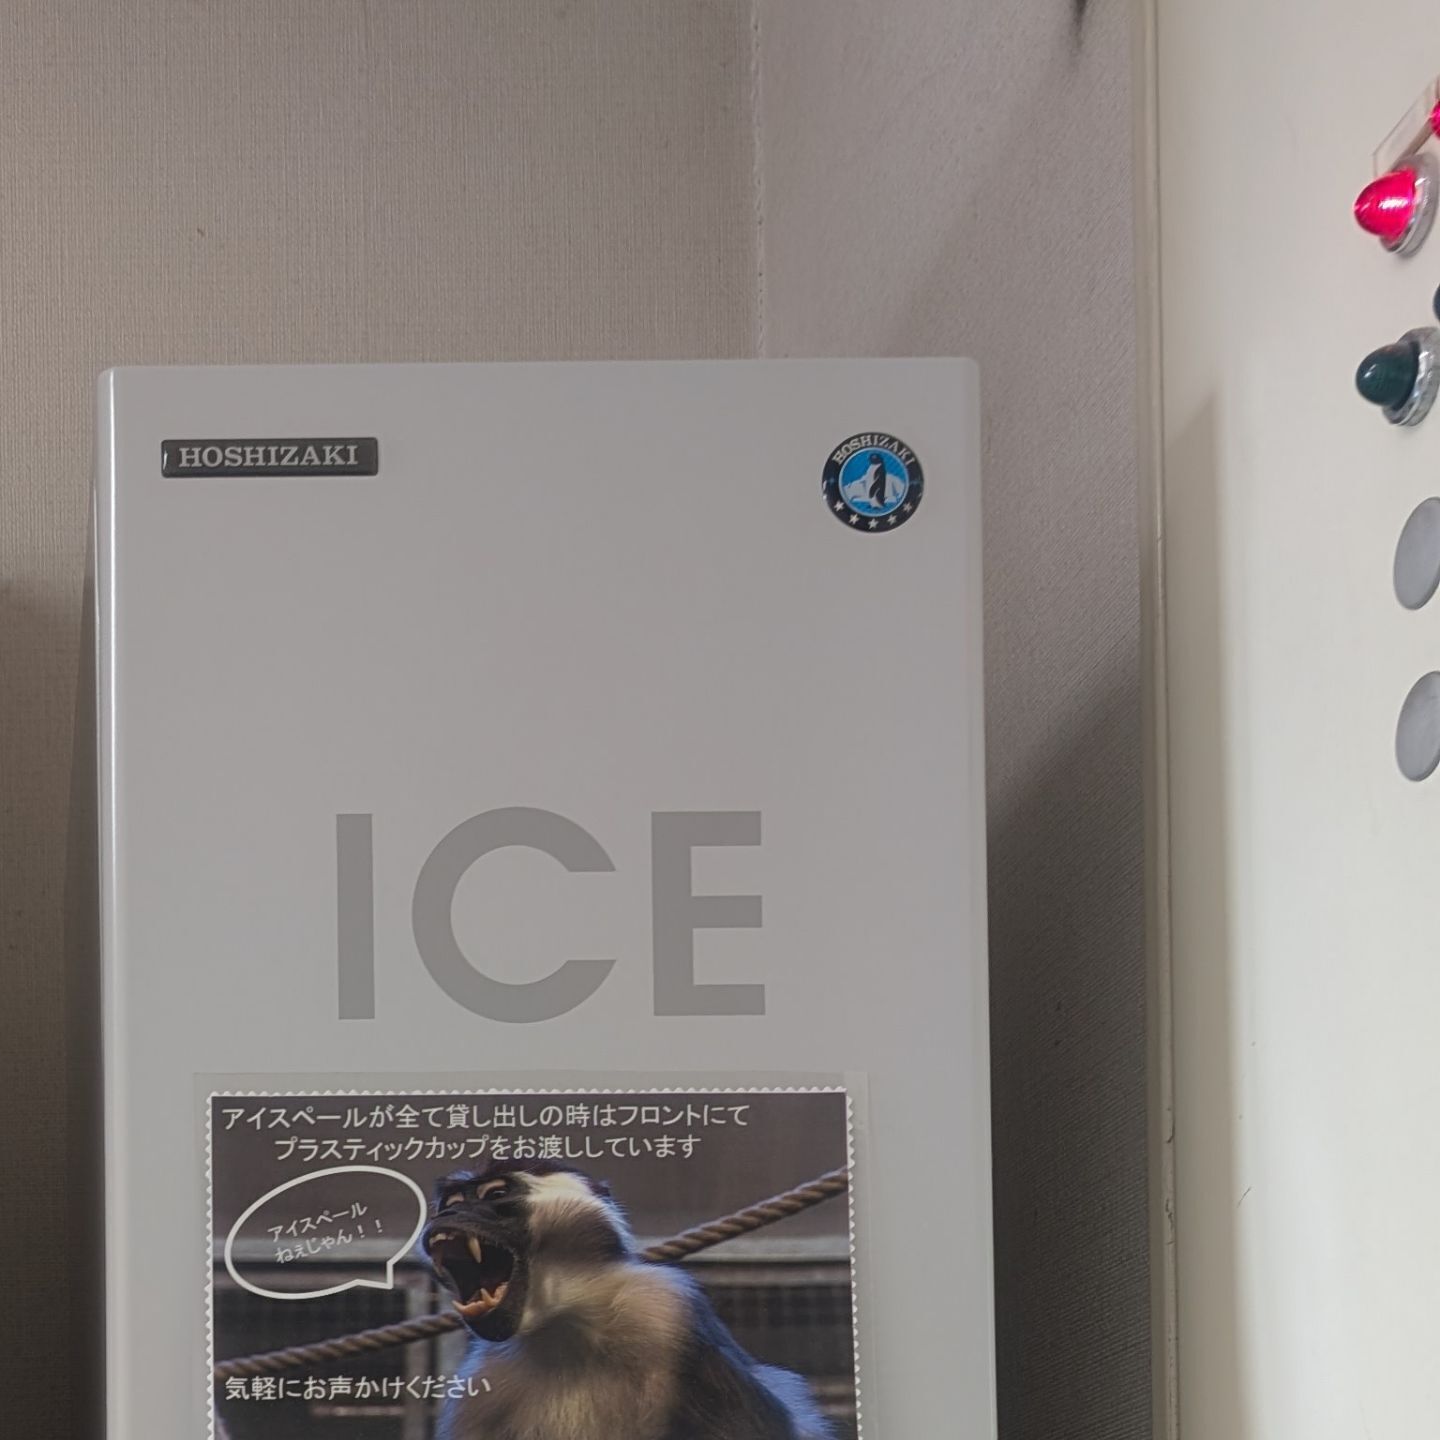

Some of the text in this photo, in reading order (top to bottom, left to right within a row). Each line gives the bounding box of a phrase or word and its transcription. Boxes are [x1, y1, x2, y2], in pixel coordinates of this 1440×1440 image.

[178, 444, 359, 468] HOSHIZAKI
[832, 434, 916, 466] HOSHIZAKI
[336, 806, 766, 1024] ICE
[221, 1103, 750, 1131] アイスペールが全て貸し出しの時はフロントにて
[274, 1133, 702, 1162] プラスティックカップをお渡ししています
[266, 1202, 369, 1243] アイスペール
[224, 1374, 492, 1401] 気軽にお声かけください
